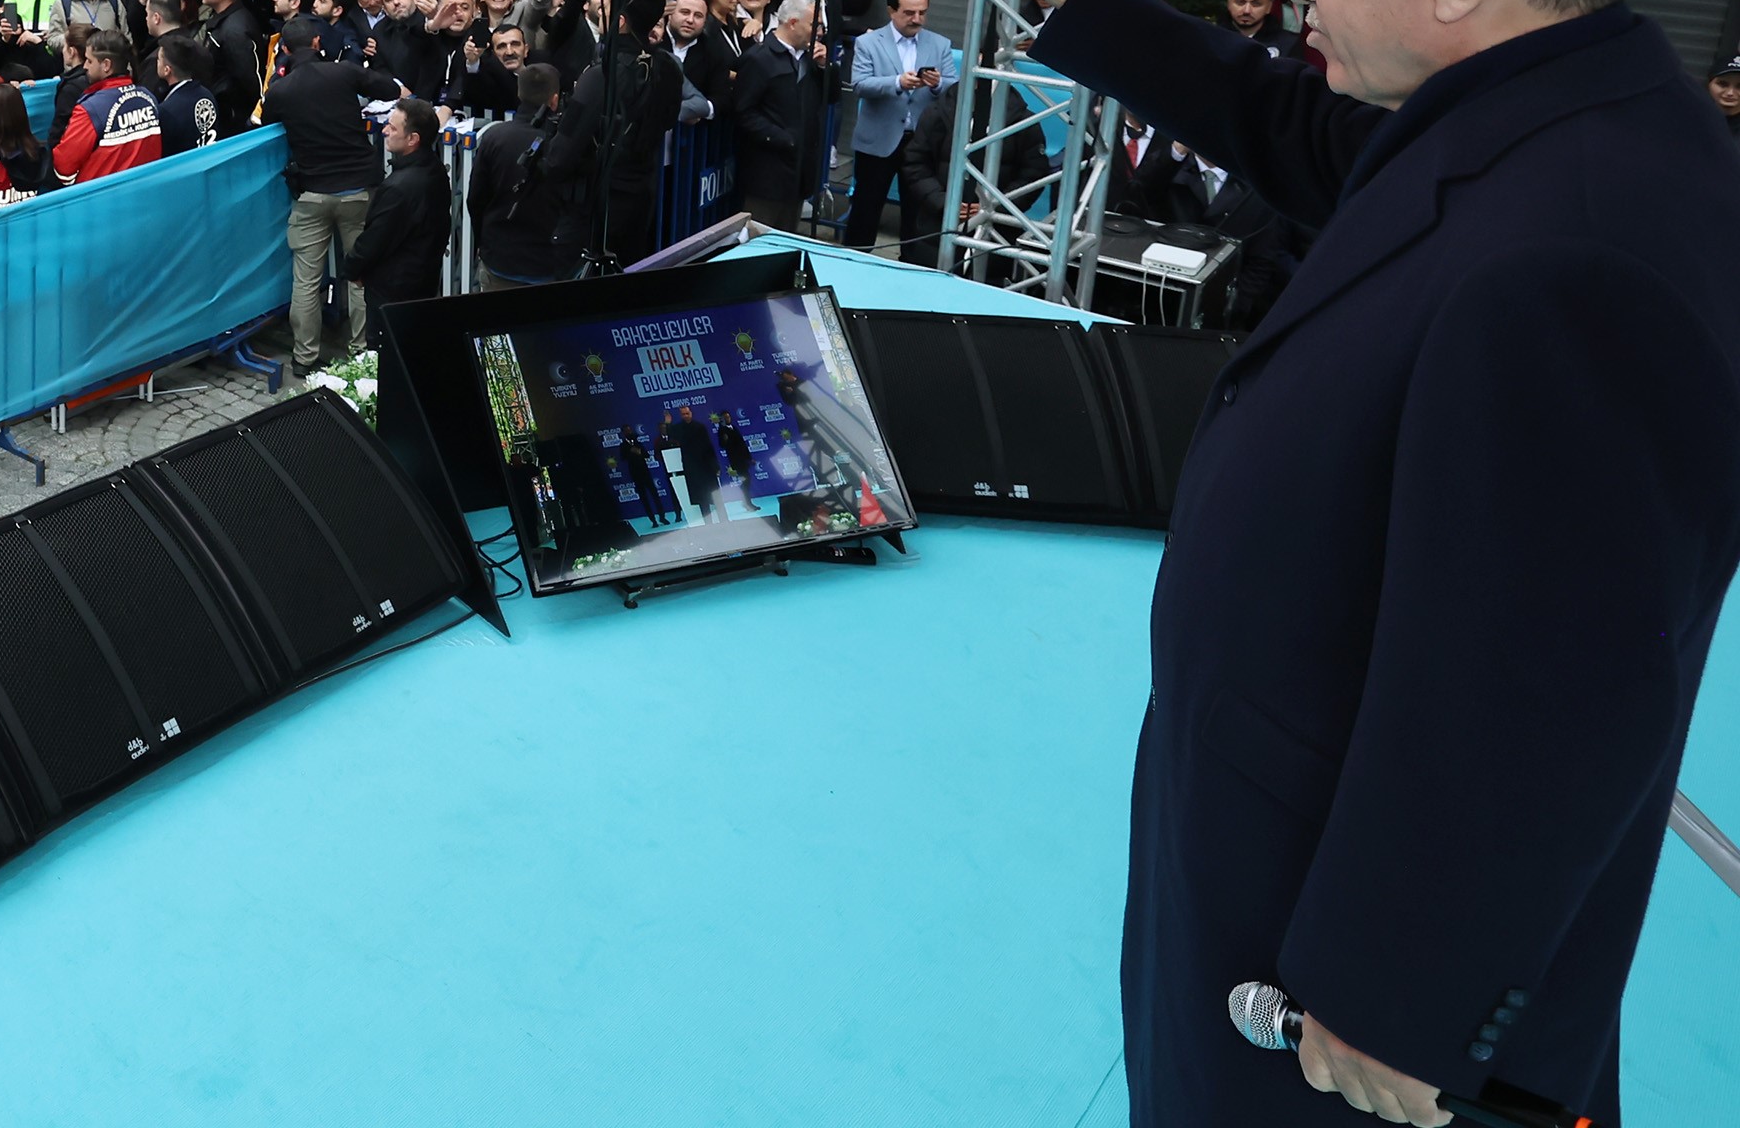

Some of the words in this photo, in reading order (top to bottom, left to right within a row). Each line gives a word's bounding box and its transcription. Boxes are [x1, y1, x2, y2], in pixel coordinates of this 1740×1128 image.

[117, 106, 156, 129] UMKE
[611, 316, 714, 348] BAHÇELİEVLER
[647, 344, 696, 372] HALK
[642, 366, 716, 394] BULUŞMASI
[127, 737, 143, 752] d&b
